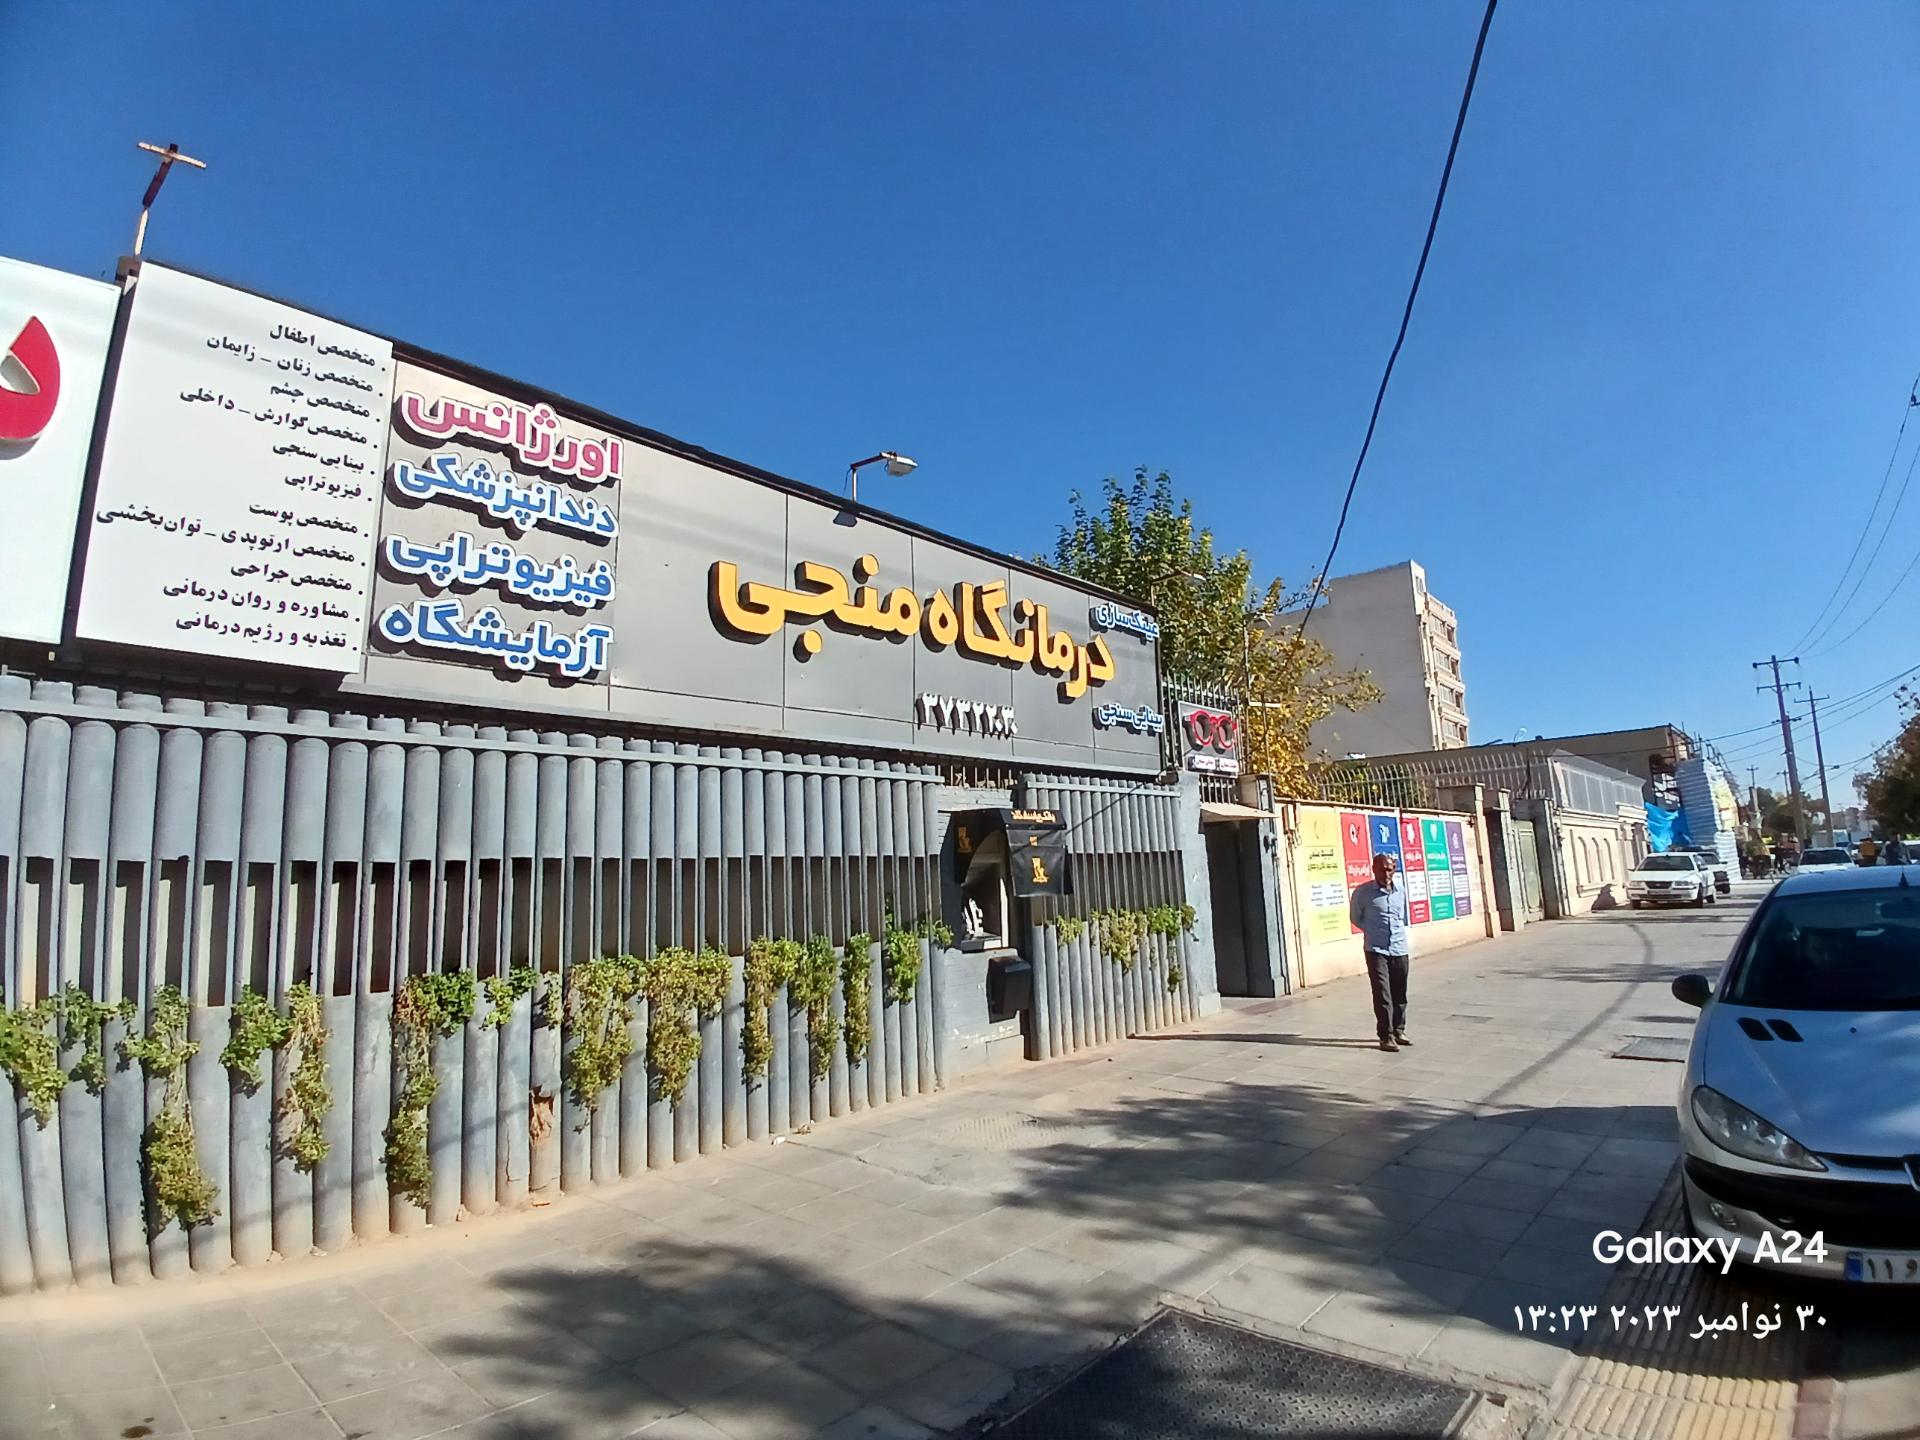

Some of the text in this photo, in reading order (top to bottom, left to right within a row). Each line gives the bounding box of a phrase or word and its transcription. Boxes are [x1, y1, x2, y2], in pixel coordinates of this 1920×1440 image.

[207, 336, 256, 361] زایمان
[269, 325, 376, 367] متخصص اطفال
[277, 358, 311, 376] زنان
[315, 371, 374, 392] متخصص
[180, 387, 235, 410] داخلی
[270, 382, 370, 418] متخصص چشم
[254, 408, 308, 430] گوارش
[307, 424, 367, 445] متخصص
[403, 392, 622, 482] اورژانس
[284, 475, 362, 499] فیزیوتراپی
[396, 455, 618, 534] دندانپزشکی
[249, 504, 358, 534] متخصص پوست
[221, 530, 289, 552] ارتوپدی
[293, 546, 355, 562] متخصص
[230, 564, 352, 591] متخصص جراحی
[387, 532, 615, 606] فیزیوتراپی
[163, 578, 228, 602] درمانی
[276, 600, 286, 613] و
[290, 601, 349, 619] مشاوره
[176, 612, 346, 648] تغذیه و رژیم درمانی
[381, 599, 613, 676] آزمایشگاه
[716, 553, 1114, 698] درمانگاه منجی
